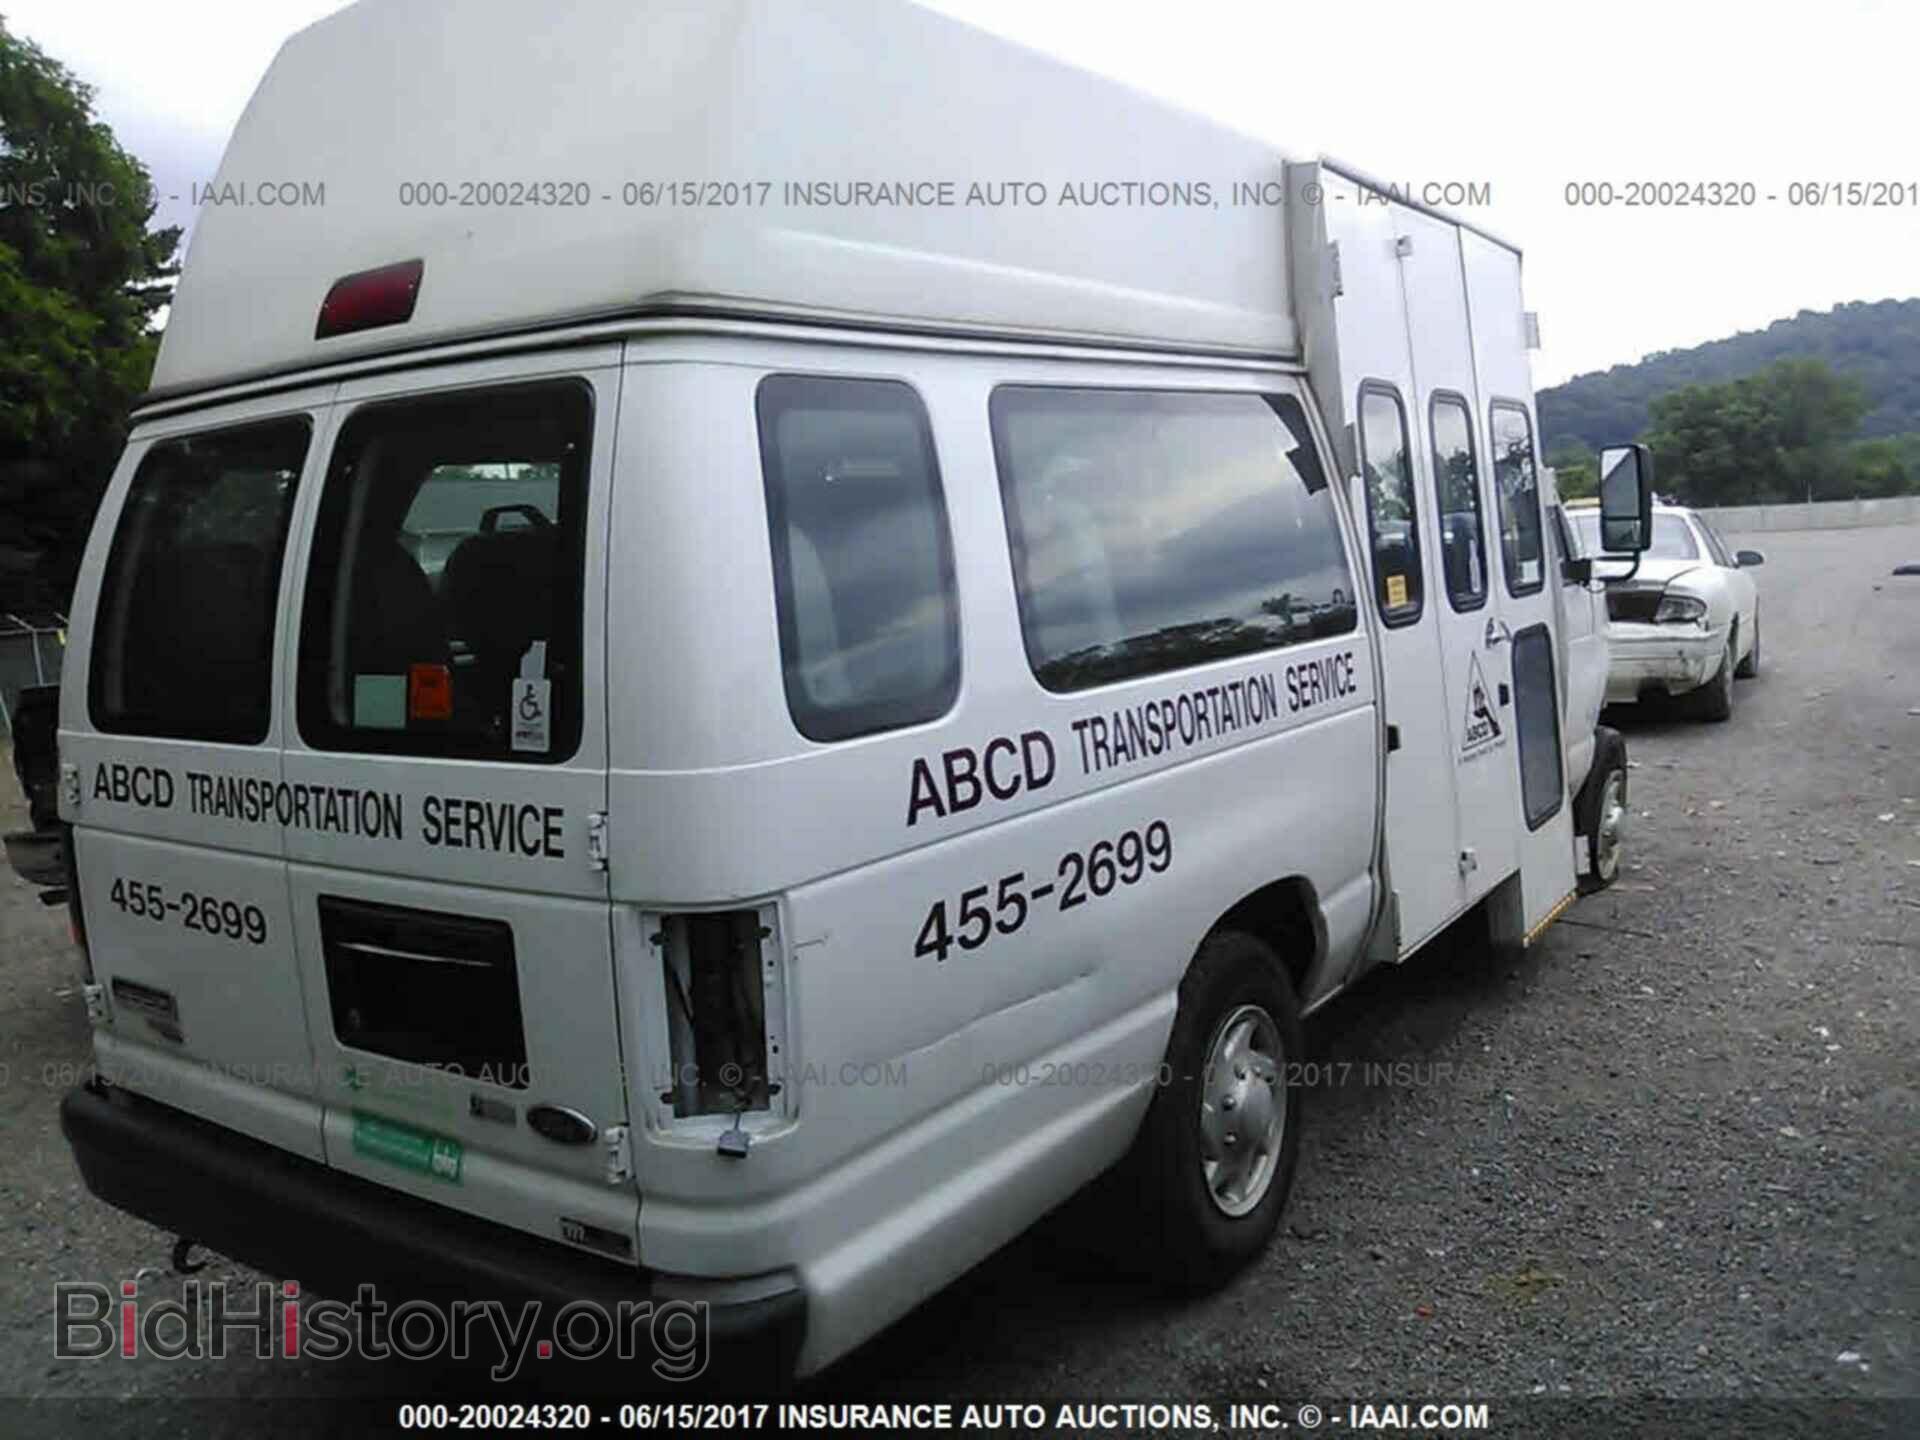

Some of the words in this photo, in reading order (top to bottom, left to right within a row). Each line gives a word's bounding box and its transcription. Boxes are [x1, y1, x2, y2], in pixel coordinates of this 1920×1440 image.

[906, 728, 1057, 827] ABCD
[1071, 673, 1277, 775] TRANSPORTATION
[1286, 650, 1358, 713] SERVICE
[93, 762, 174, 808] ABCD
[186, 772, 403, 841] TRANSPORTATION
[423, 795, 566, 859] SERVICE
[110, 877, 267, 945] 455-2699
[914, 819, 1173, 963] 455-2699
